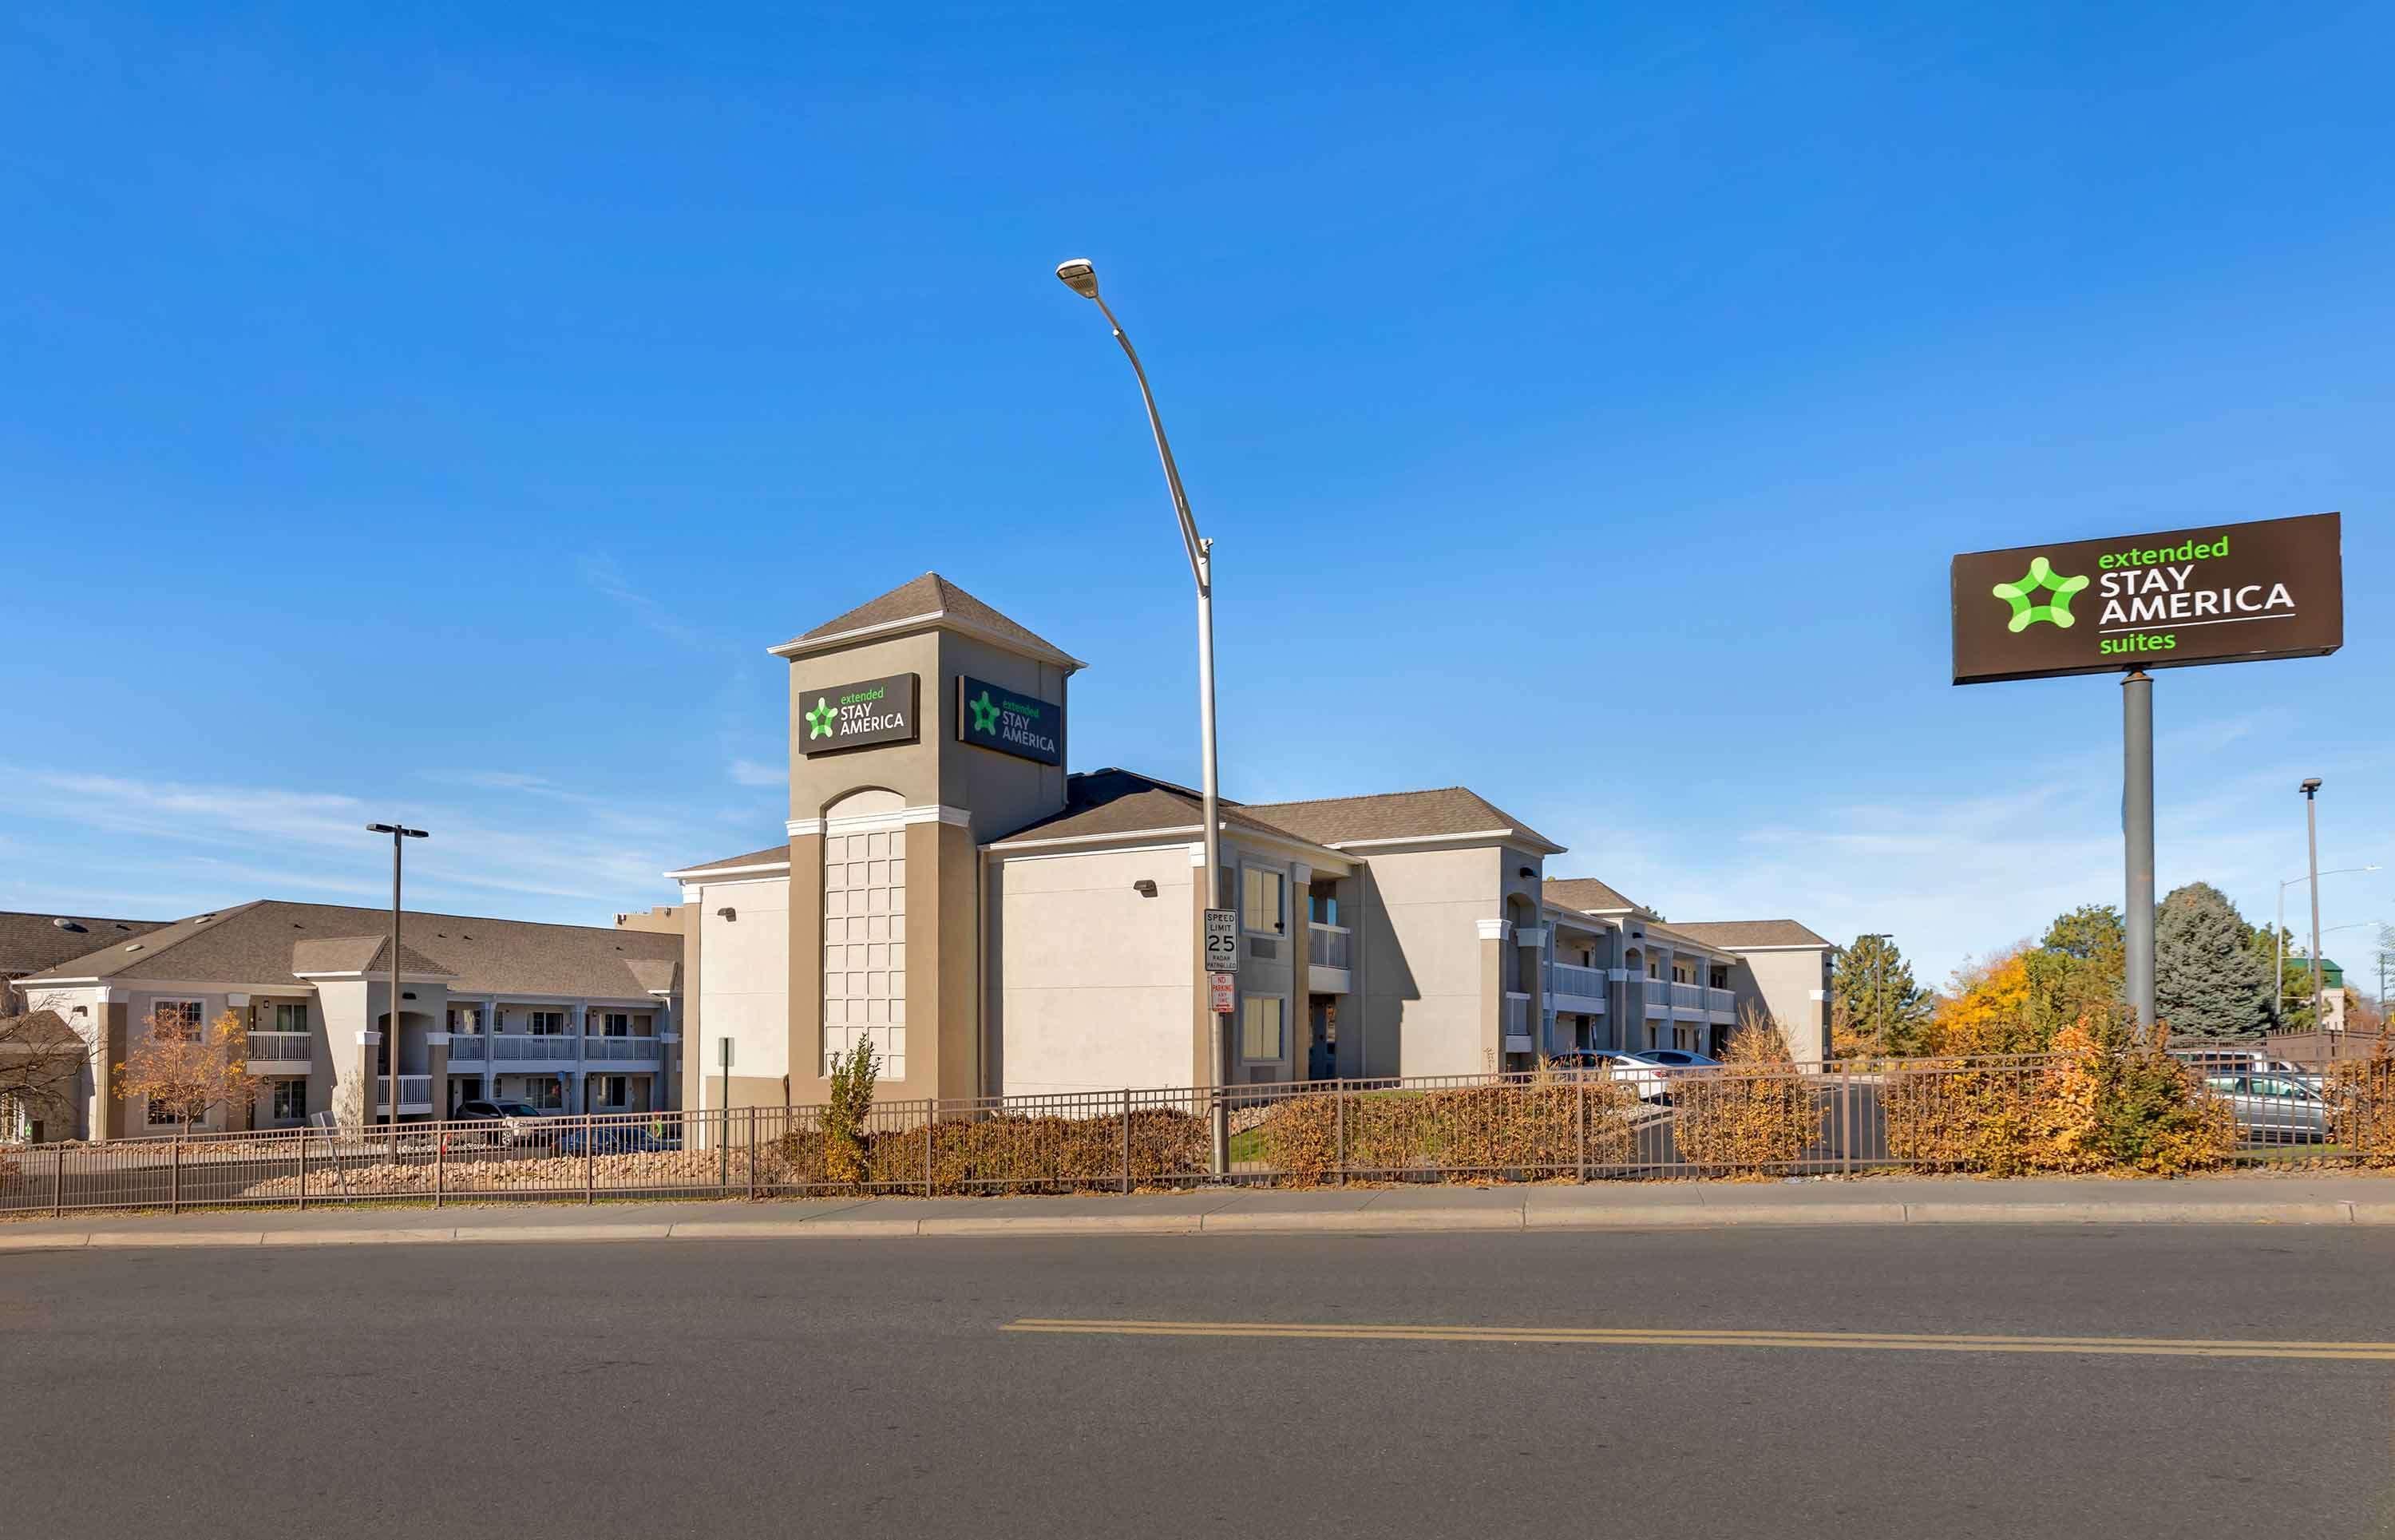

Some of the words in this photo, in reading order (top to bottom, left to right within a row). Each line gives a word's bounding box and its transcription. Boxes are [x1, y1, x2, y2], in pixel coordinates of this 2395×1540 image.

[2098, 536, 2229, 568] extended
[2100, 564, 2195, 598] STAY
[2099, 583, 2295, 625] AMERICA
[2100, 633, 2176, 655] suites
[841, 687, 884, 704] extended
[841, 702, 874, 720] STAY
[1003, 699, 1039, 717] extended
[840, 712, 905, 736] AMERICA
[1003, 711, 1030, 730] STAY
[1003, 730, 1055, 753] AMERICA
[1207, 913, 1234, 922] SPEED
[1208, 935, 1235, 952] 25
